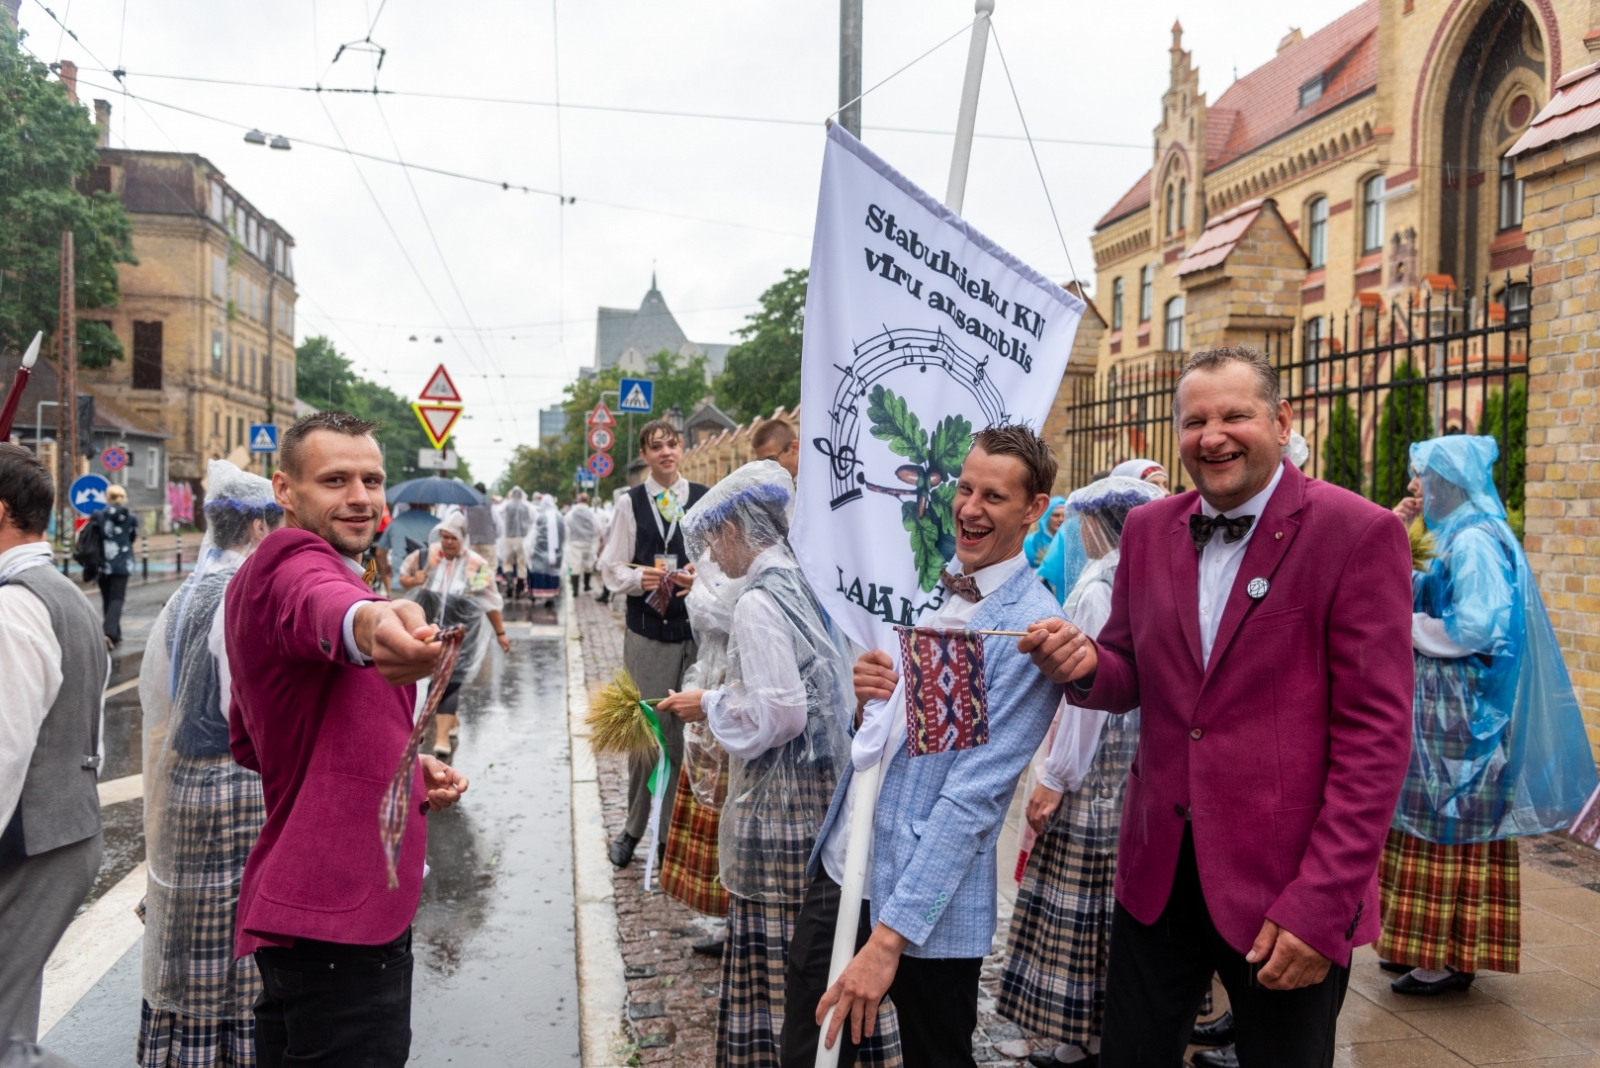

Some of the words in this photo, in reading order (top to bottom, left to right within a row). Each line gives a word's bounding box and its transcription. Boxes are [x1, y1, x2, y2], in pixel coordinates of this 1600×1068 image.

[865, 204, 1009, 319] Stabulnieku
[1011, 302, 1046, 342] KN
[928, 291, 1033, 374] ansamblis
